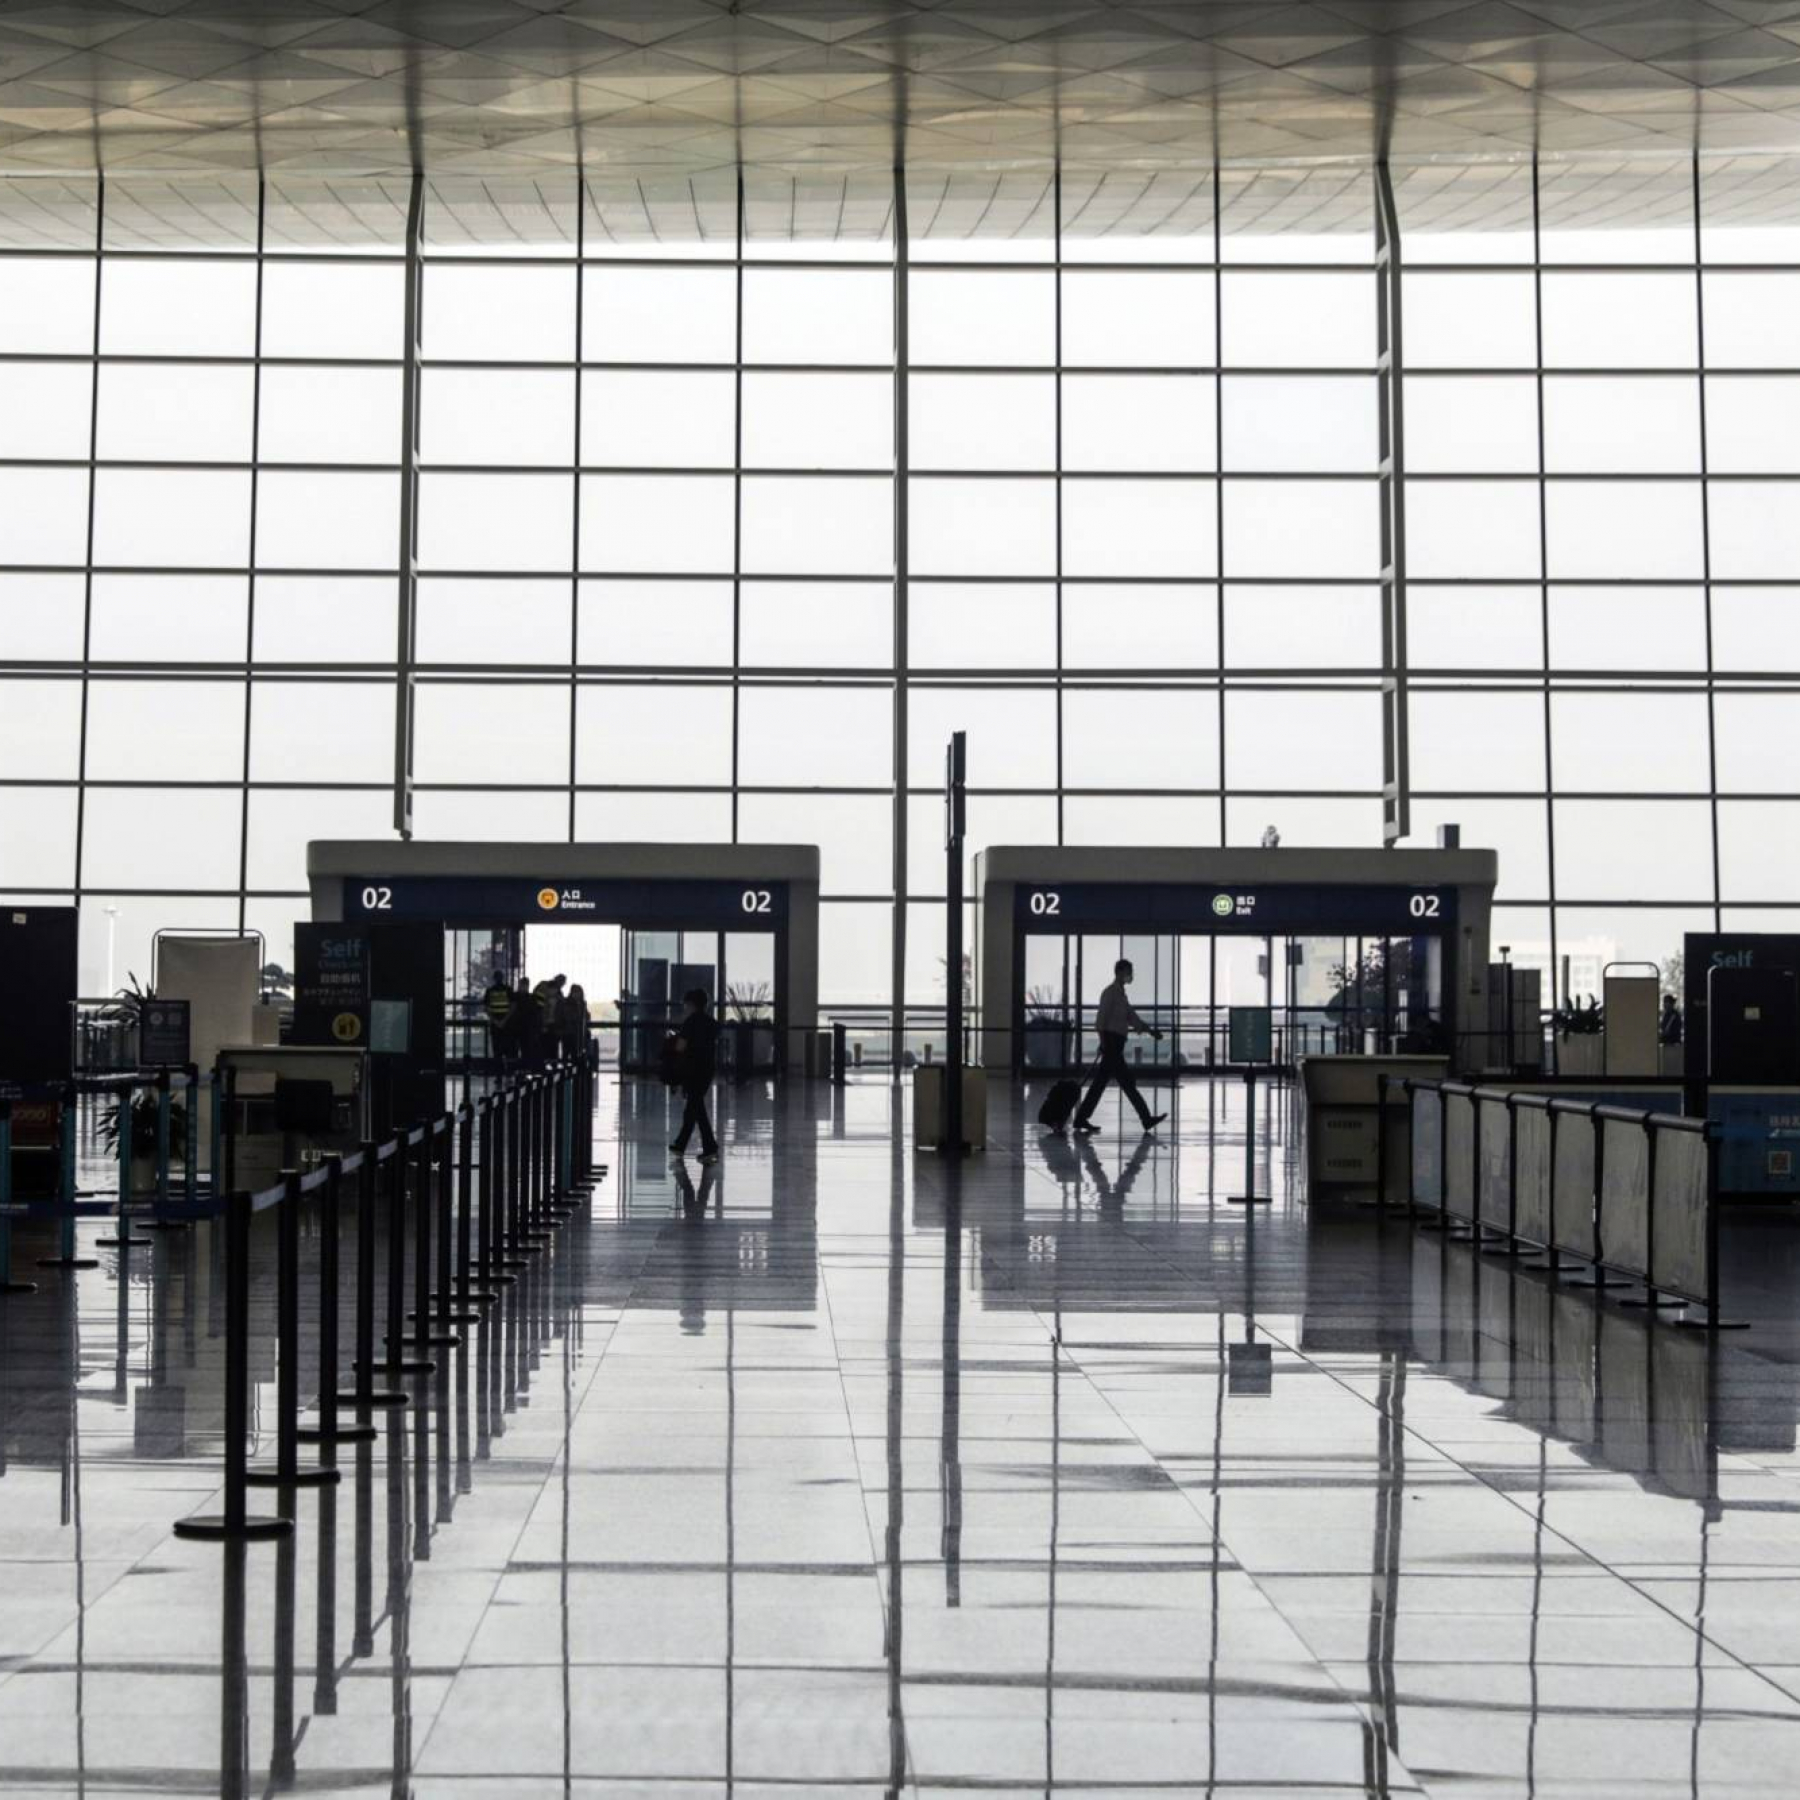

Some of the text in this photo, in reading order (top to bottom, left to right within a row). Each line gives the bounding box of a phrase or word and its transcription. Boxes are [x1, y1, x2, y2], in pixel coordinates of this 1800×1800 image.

[362, 887, 392, 909] 02
[561, 889, 580, 900] 入口
[561, 900, 596, 909] Entrance
[742, 890, 771, 912] 02
[1030, 892, 1060, 915] 02
[1236, 906, 1251, 915] Exit
[1409, 895, 1440, 917] 02
[320, 938, 362, 958] Self
[1711, 950, 1753, 968] Self
